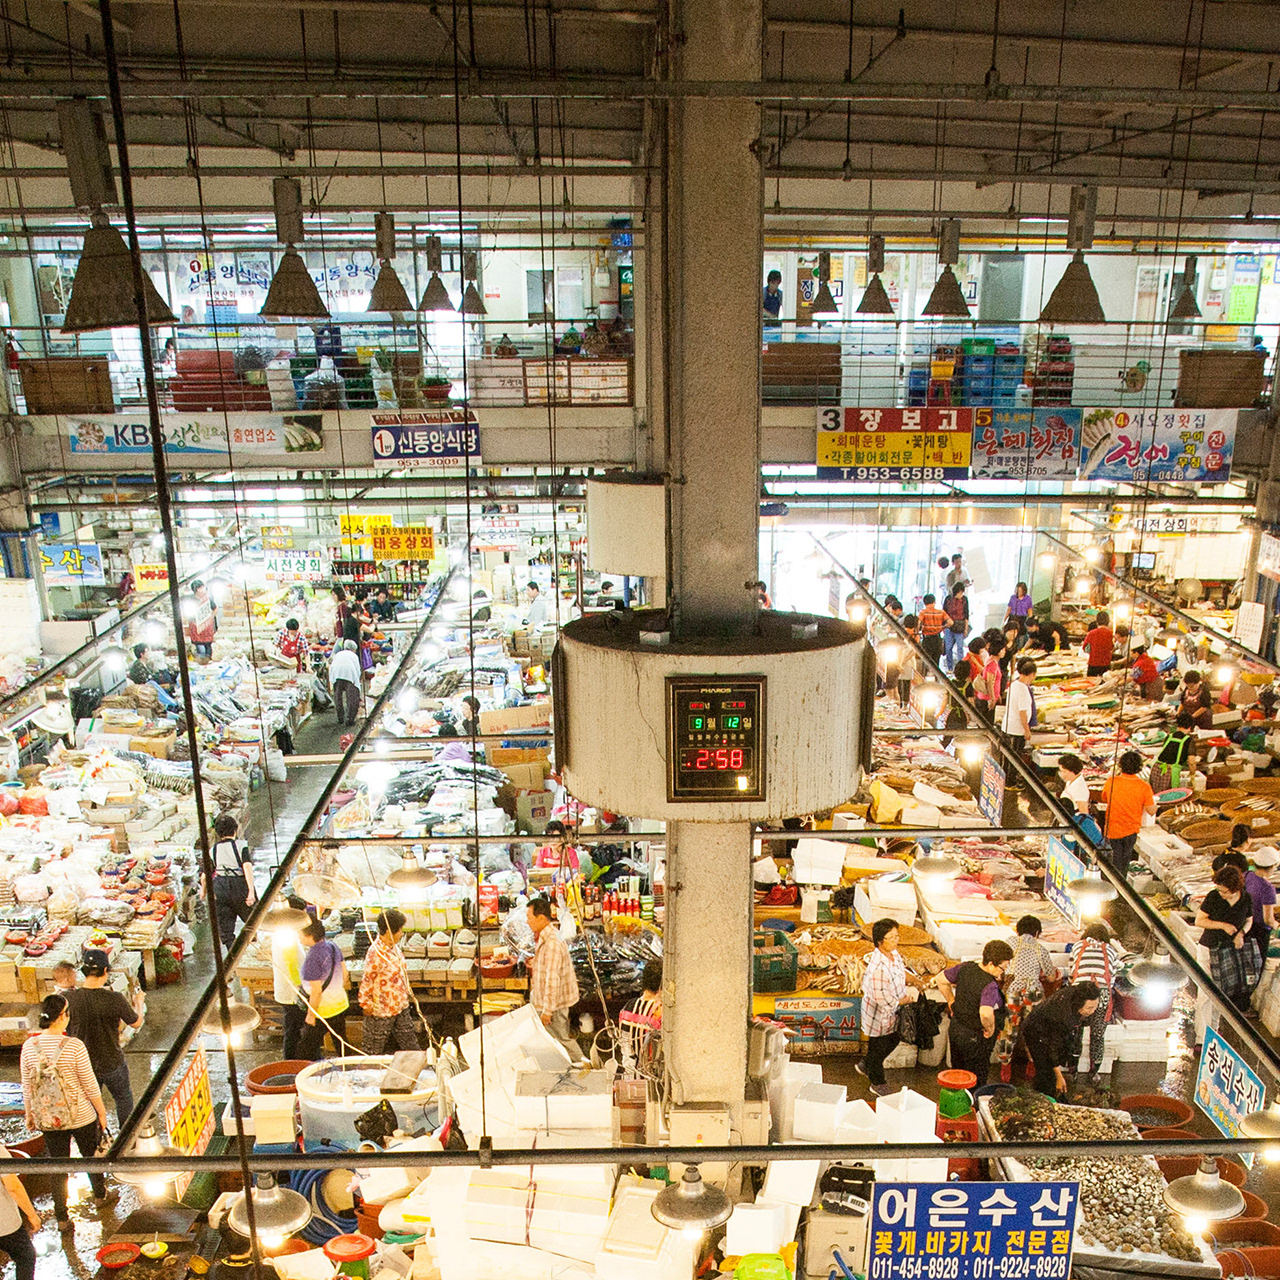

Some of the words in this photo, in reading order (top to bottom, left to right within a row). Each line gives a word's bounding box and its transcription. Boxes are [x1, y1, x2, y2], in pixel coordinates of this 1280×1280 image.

[821, 408, 841, 431] 3
[233, 427, 277, 444] 출연업소
[398, 428, 478, 454] 신동양식당
[397, 457, 459, 467] 953-3009
[1132, 470, 1185, 481] 95-0448
[694, 748, 744, 770] 2:58
[877, 1187, 1075, 1228] 어은수산
[1006, 1229, 1072, 1256] 전문점
[872, 1256, 959, 1279] 011-454-8928
[973, 1255, 1067, 1279] 011-9224-8928
